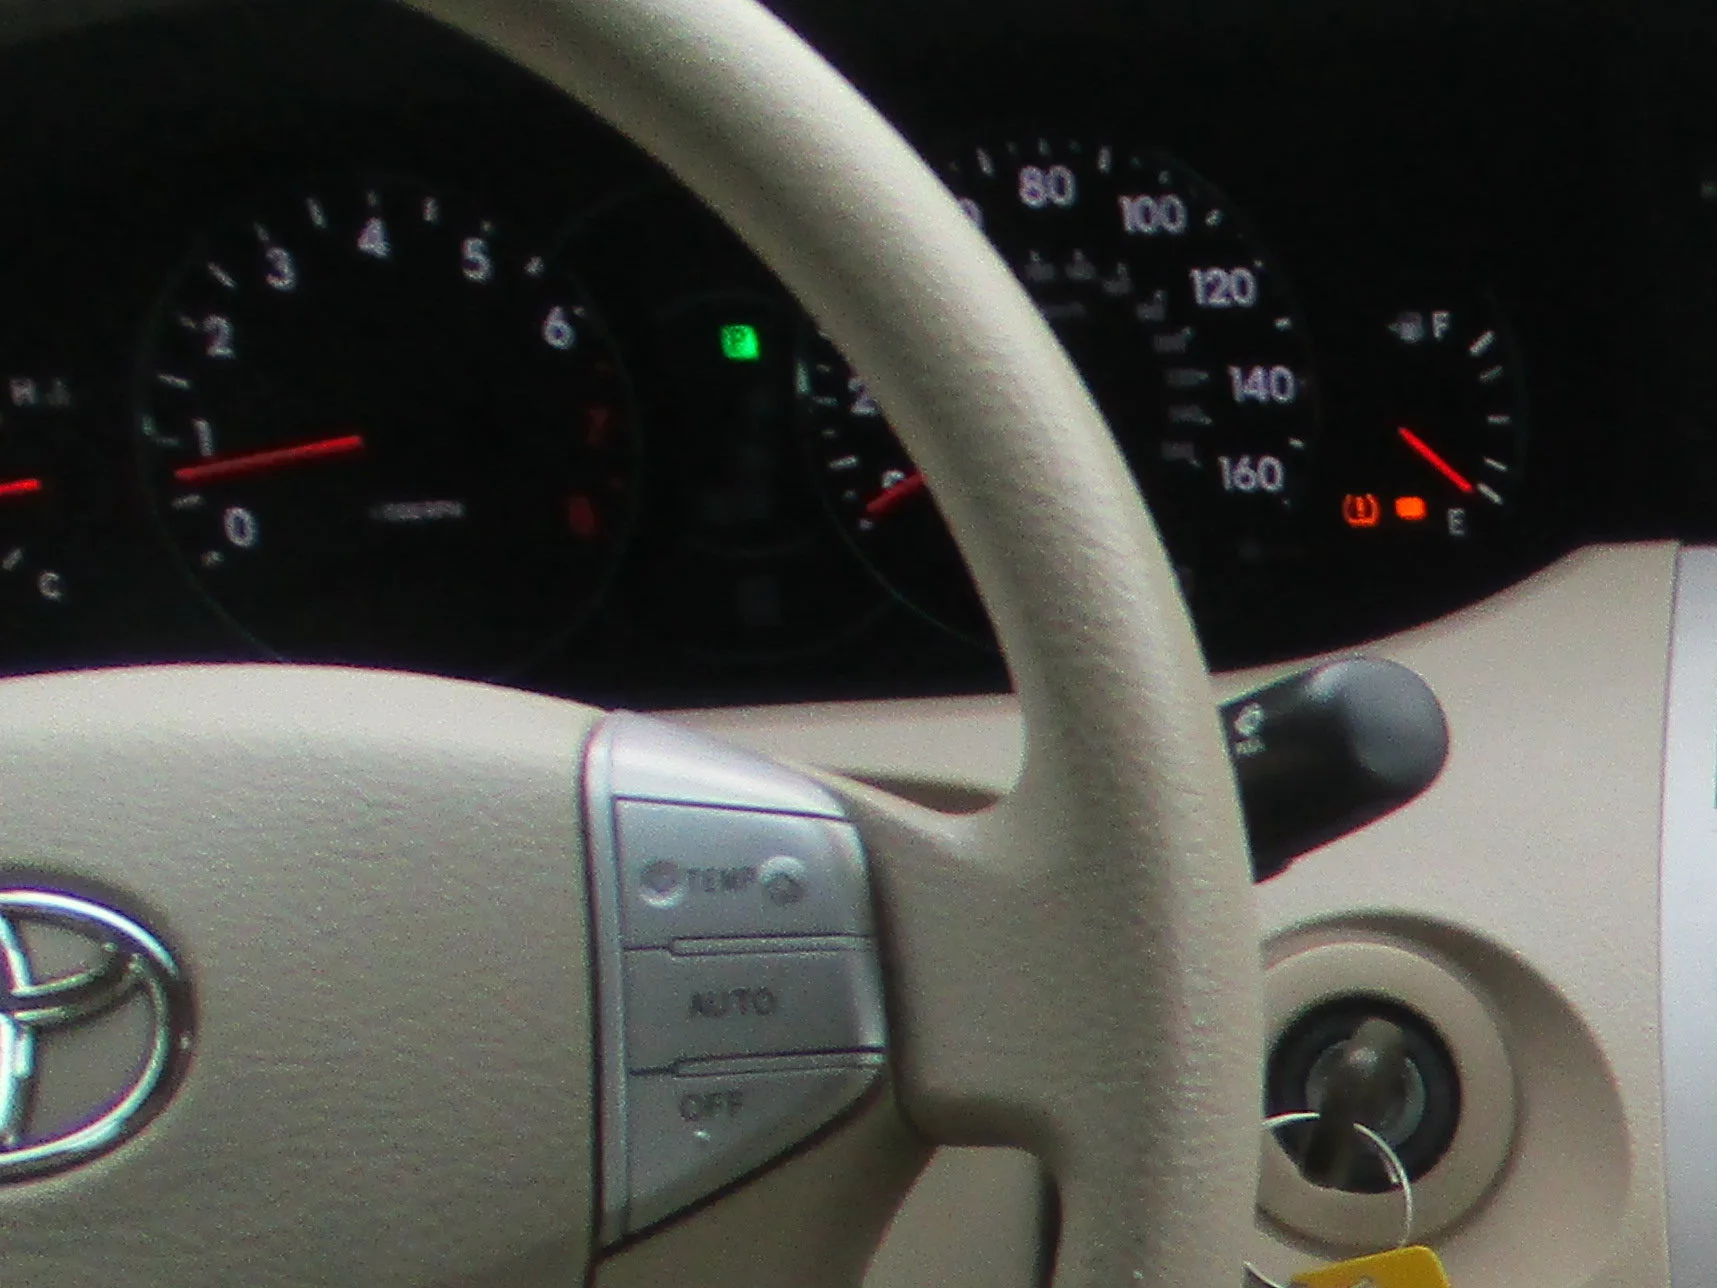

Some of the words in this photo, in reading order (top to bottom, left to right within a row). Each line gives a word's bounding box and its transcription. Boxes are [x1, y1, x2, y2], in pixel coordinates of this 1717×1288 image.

[1018, 164, 1076, 208] 80
[1117, 193, 1189, 234] 100
[357, 216, 391, 259] 4
[264, 247, 297, 291] 3
[460, 236, 494, 283] 5
[1190, 266, 1258, 307] 120
[200, 314, 235, 358] 2
[542, 305, 575, 350] 6
[1432, 309, 1450, 341] F
[1227, 364, 1297, 404] 140
[1218, 454, 1286, 493] 160
[223, 505, 257, 548] 0
[1448, 507, 1467, 536] E
[686, 866, 756, 893] TEMP
[689, 985, 778, 1019] AUTO
[679, 1089, 744, 1123] OFF
